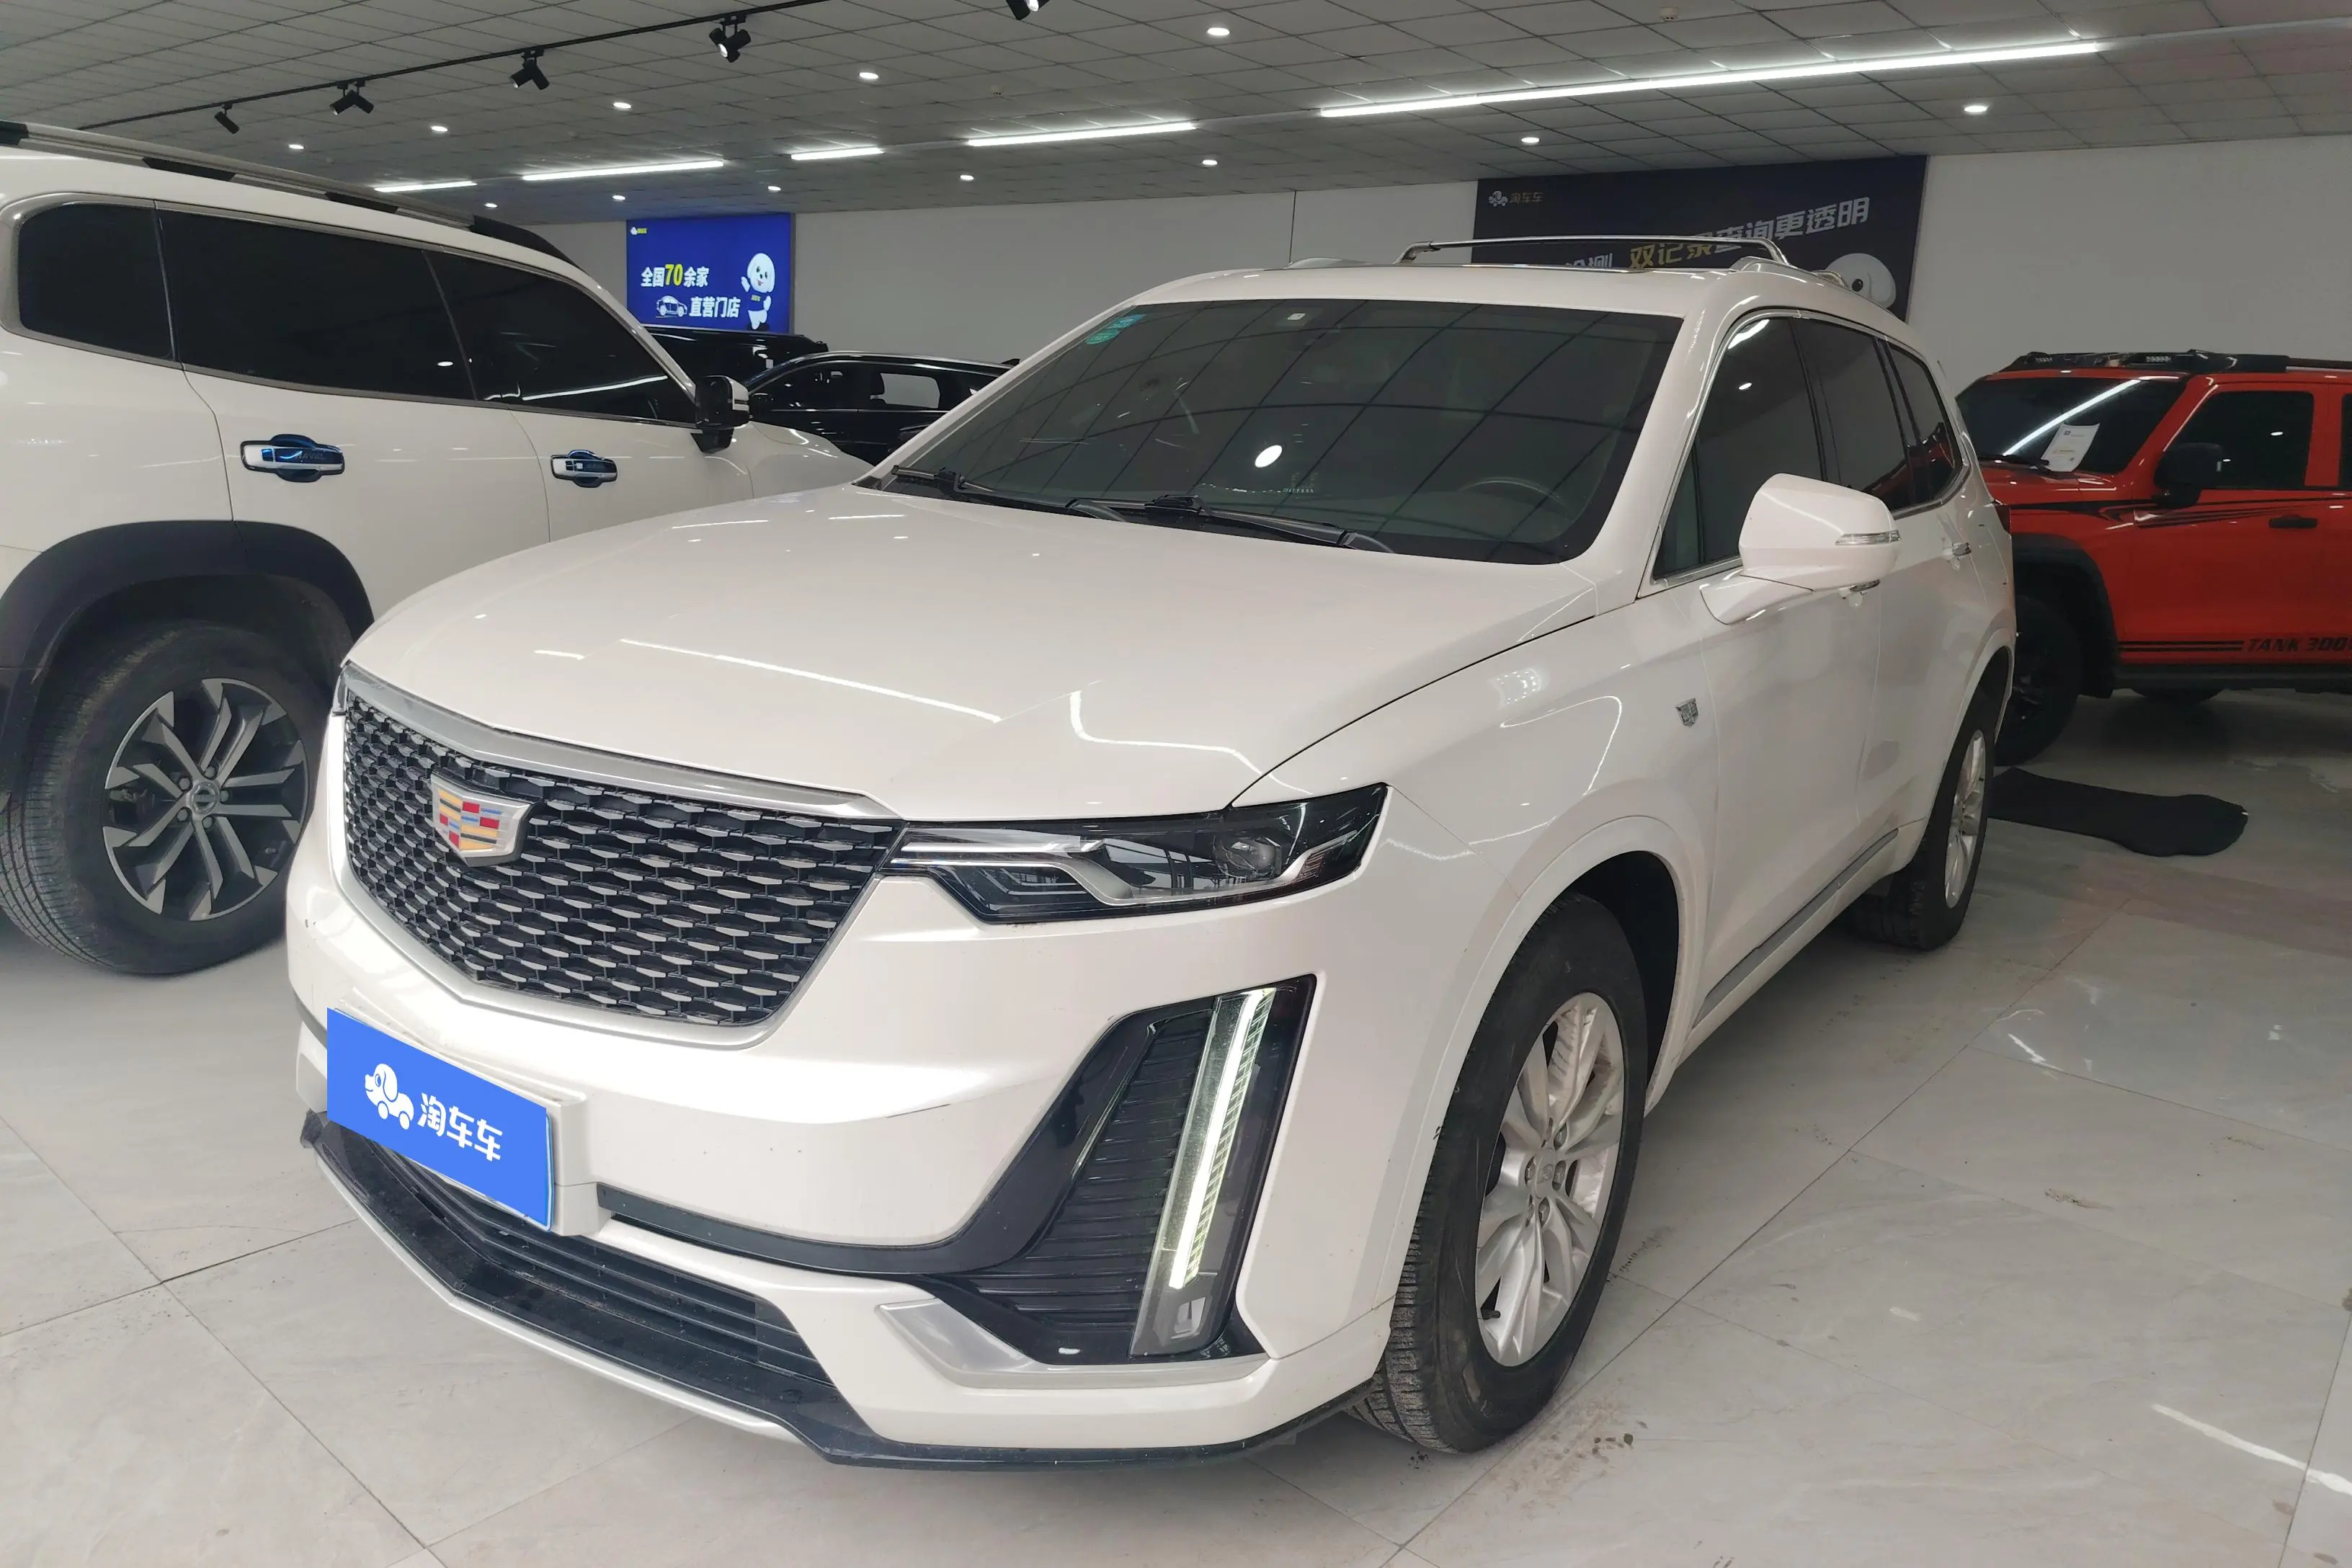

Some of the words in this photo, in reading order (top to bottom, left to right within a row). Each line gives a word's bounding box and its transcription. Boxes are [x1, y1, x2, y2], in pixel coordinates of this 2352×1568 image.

[641, 264, 710, 288] 全国70余家
[689, 296, 741, 318] 直营门店
[2248, 638, 2299, 652] TANK
